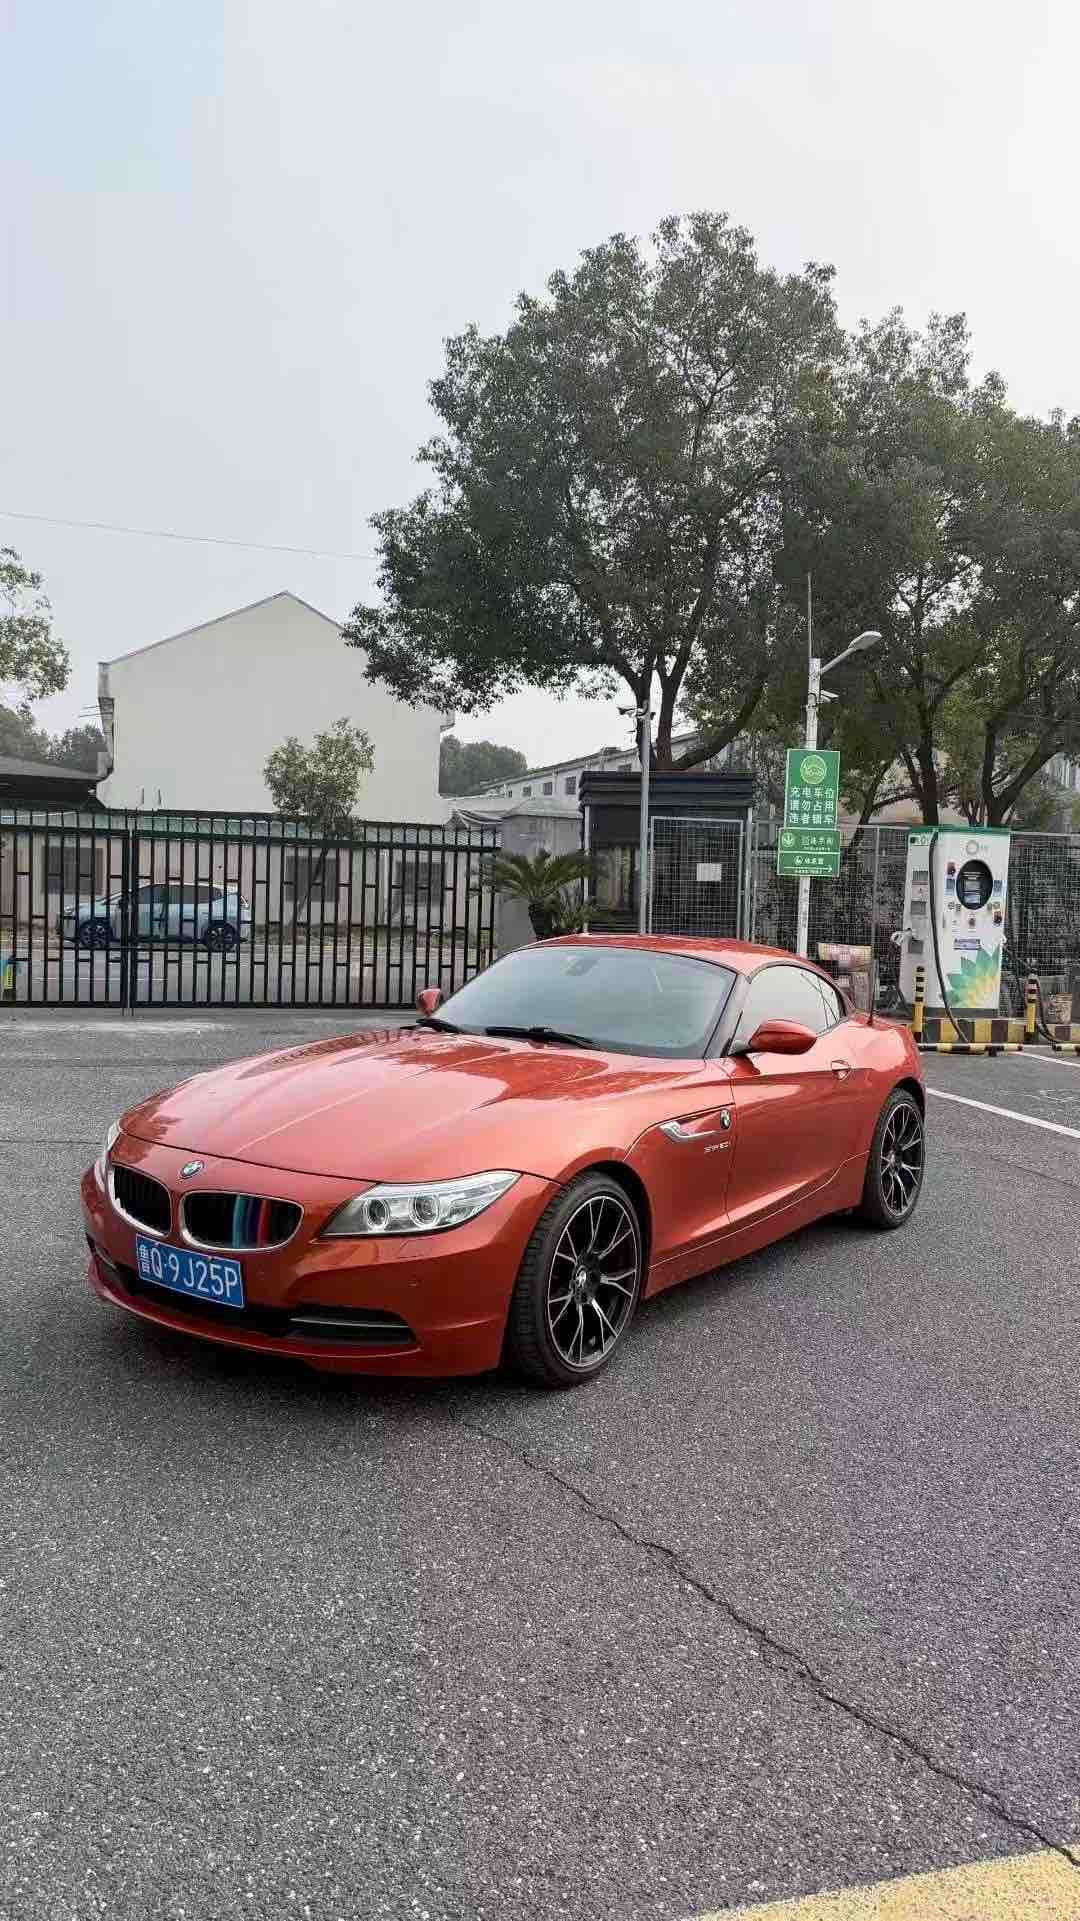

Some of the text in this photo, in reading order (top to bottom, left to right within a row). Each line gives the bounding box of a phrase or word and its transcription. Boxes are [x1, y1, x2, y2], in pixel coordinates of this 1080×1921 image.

[790, 799, 834, 812] 请勿占用
[789, 812, 834, 824] 违者锁车
